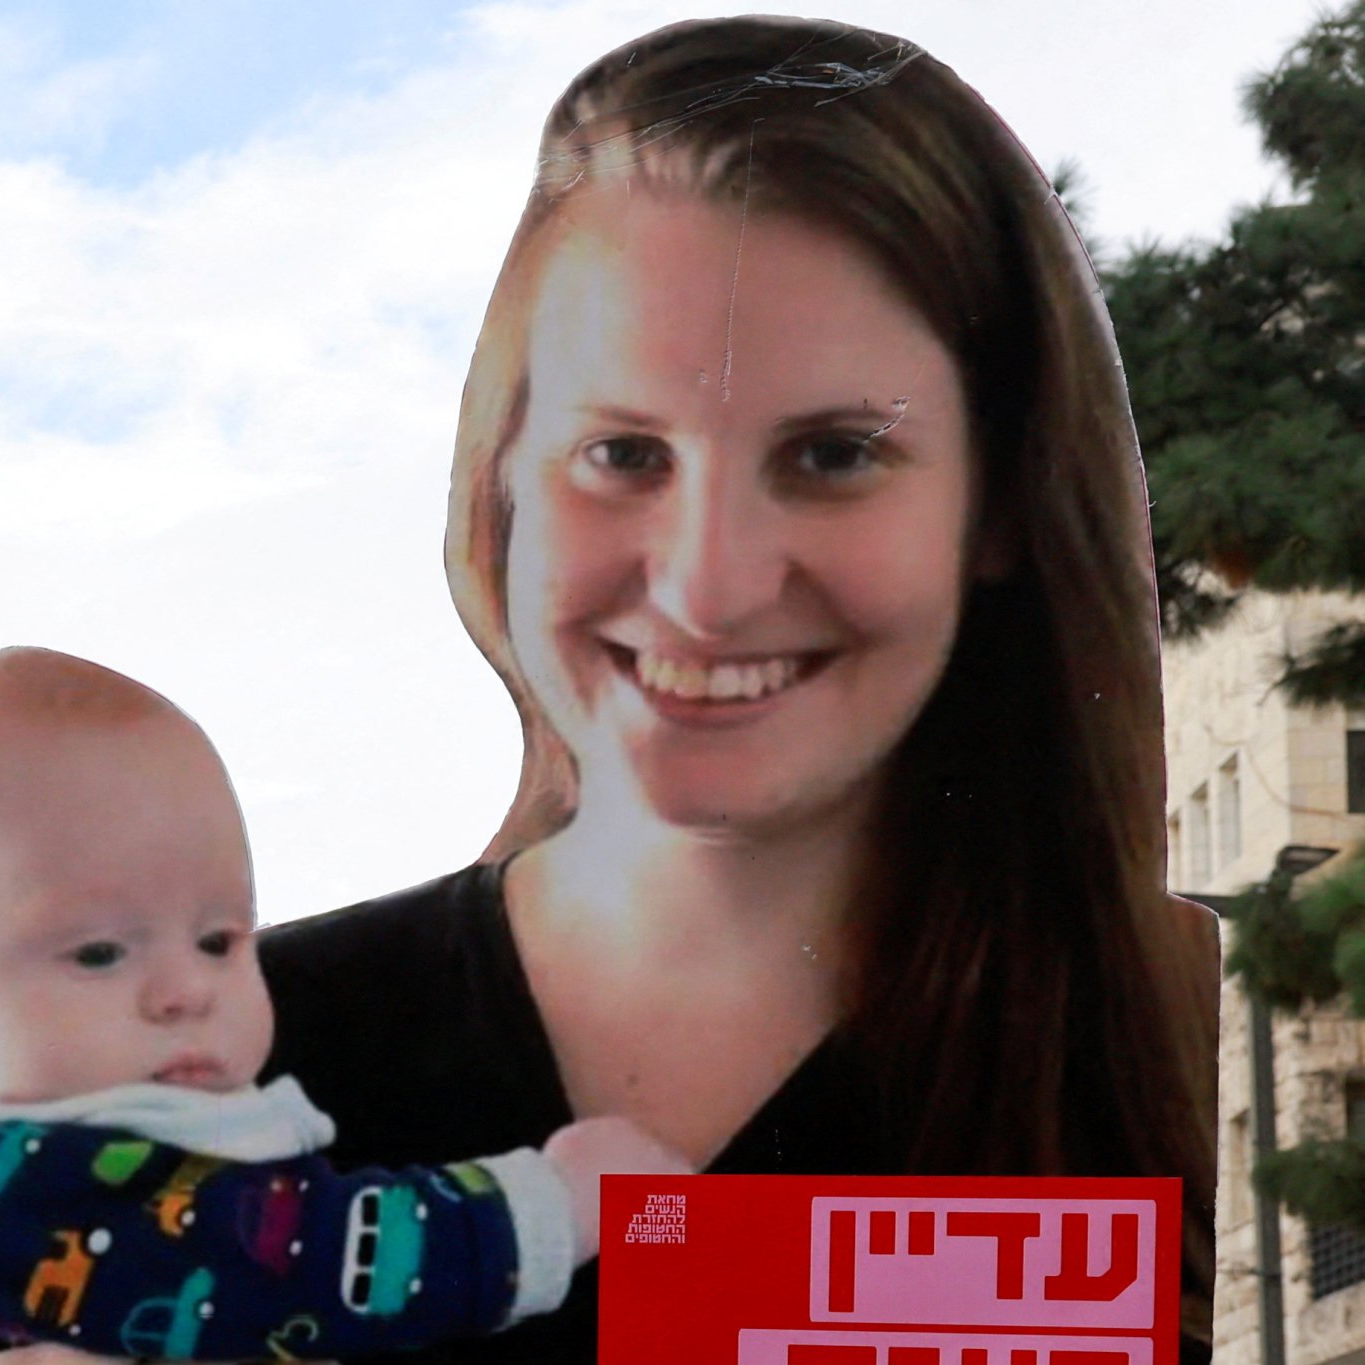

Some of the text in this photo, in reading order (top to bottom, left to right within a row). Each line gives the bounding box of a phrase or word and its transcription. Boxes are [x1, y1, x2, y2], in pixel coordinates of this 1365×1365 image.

[647, 1195, 686, 1204] מחאת
[645, 1204, 686, 1214] הנשים
[632, 1213, 686, 1224] להחזרת
[628, 1222, 685, 1233] החטופות
[625, 1233, 685, 1244] והחטופים
[829, 1211, 1138, 1312] עדיין
